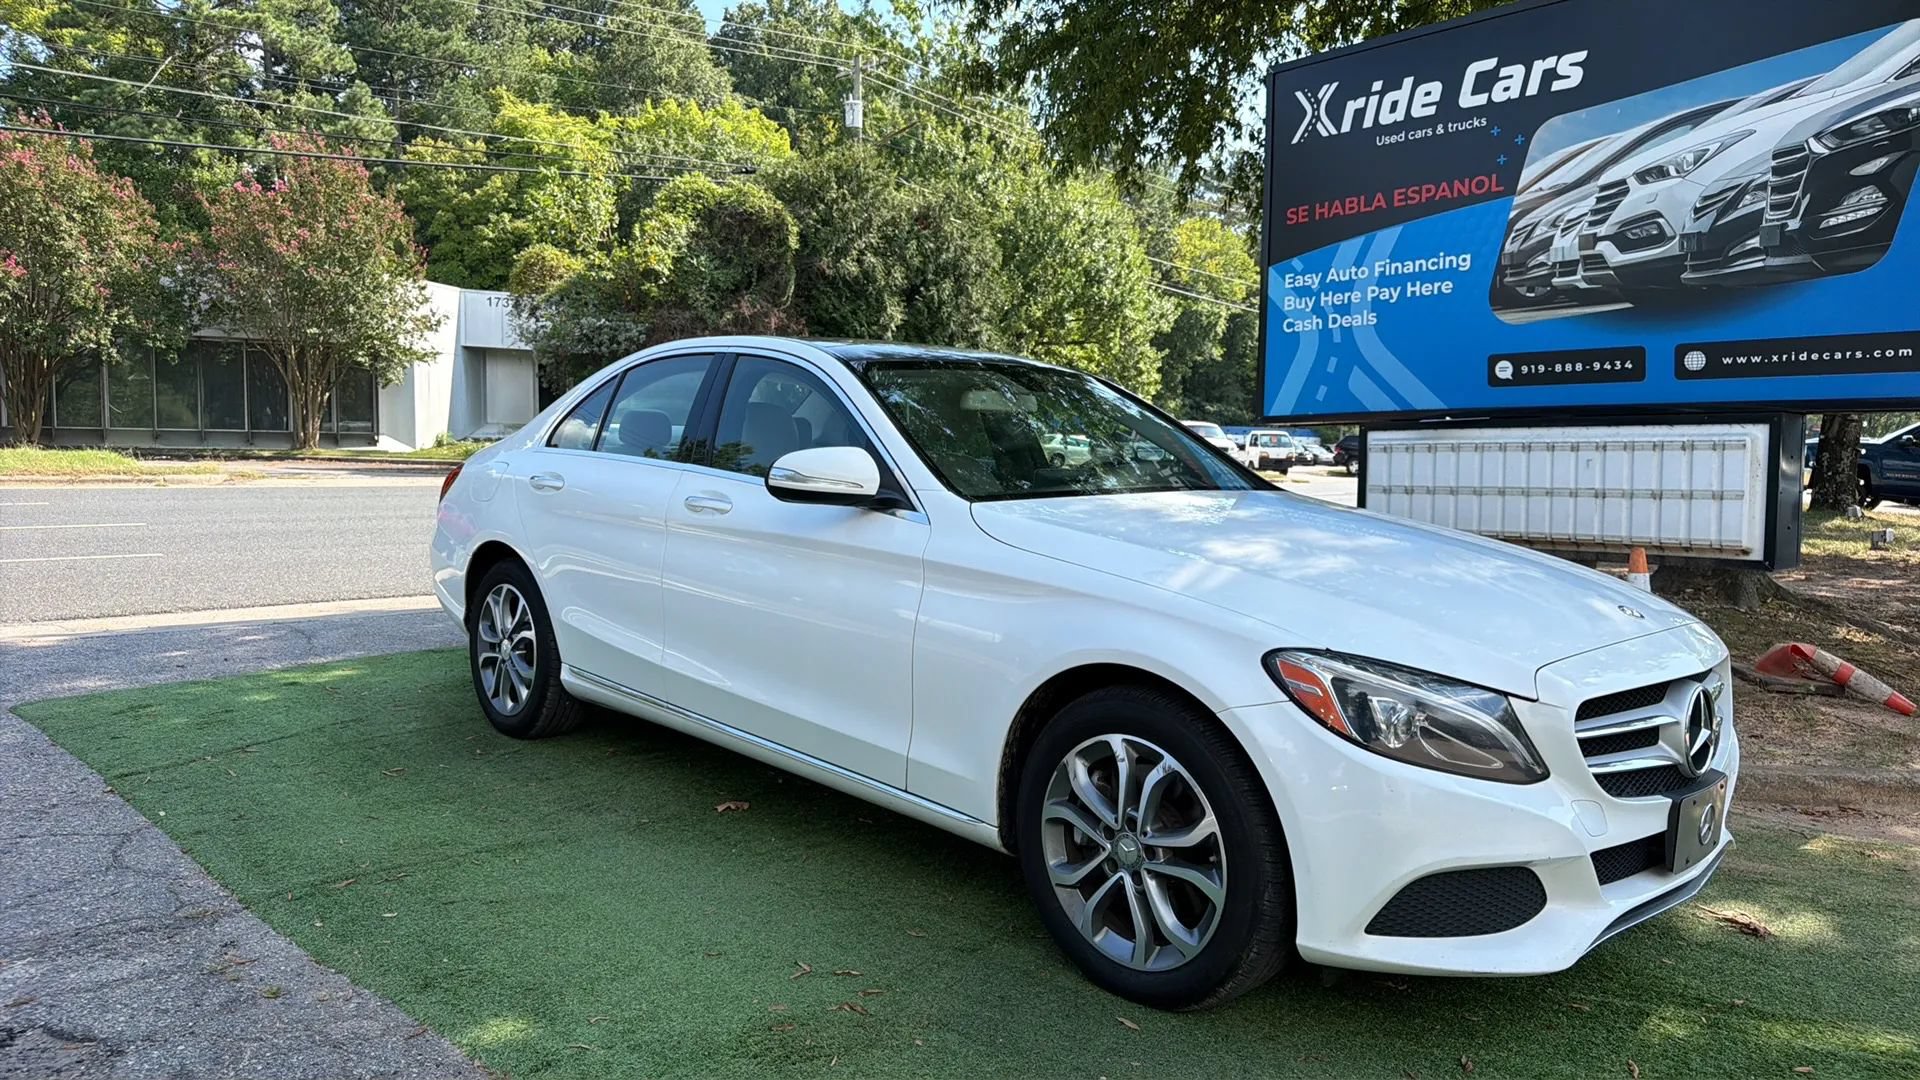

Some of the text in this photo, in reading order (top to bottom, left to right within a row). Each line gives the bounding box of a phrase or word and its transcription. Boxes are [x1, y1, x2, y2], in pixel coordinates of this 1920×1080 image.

[1458, 50, 1589, 110] Cars
[1376, 116, 1488, 147] Used cars & trucks
[1286, 174, 1505, 226] SE HABLA ESPANOL
[1284, 251, 1472, 290] Easy Auto Financing
[1283, 278, 1454, 313] Buy Here Pay Here
[1282, 309, 1378, 334] Cash Deals
[1520, 359, 1634, 375] 919-888-9434
[1721, 346, 1914, 365] www.xridecars.com
